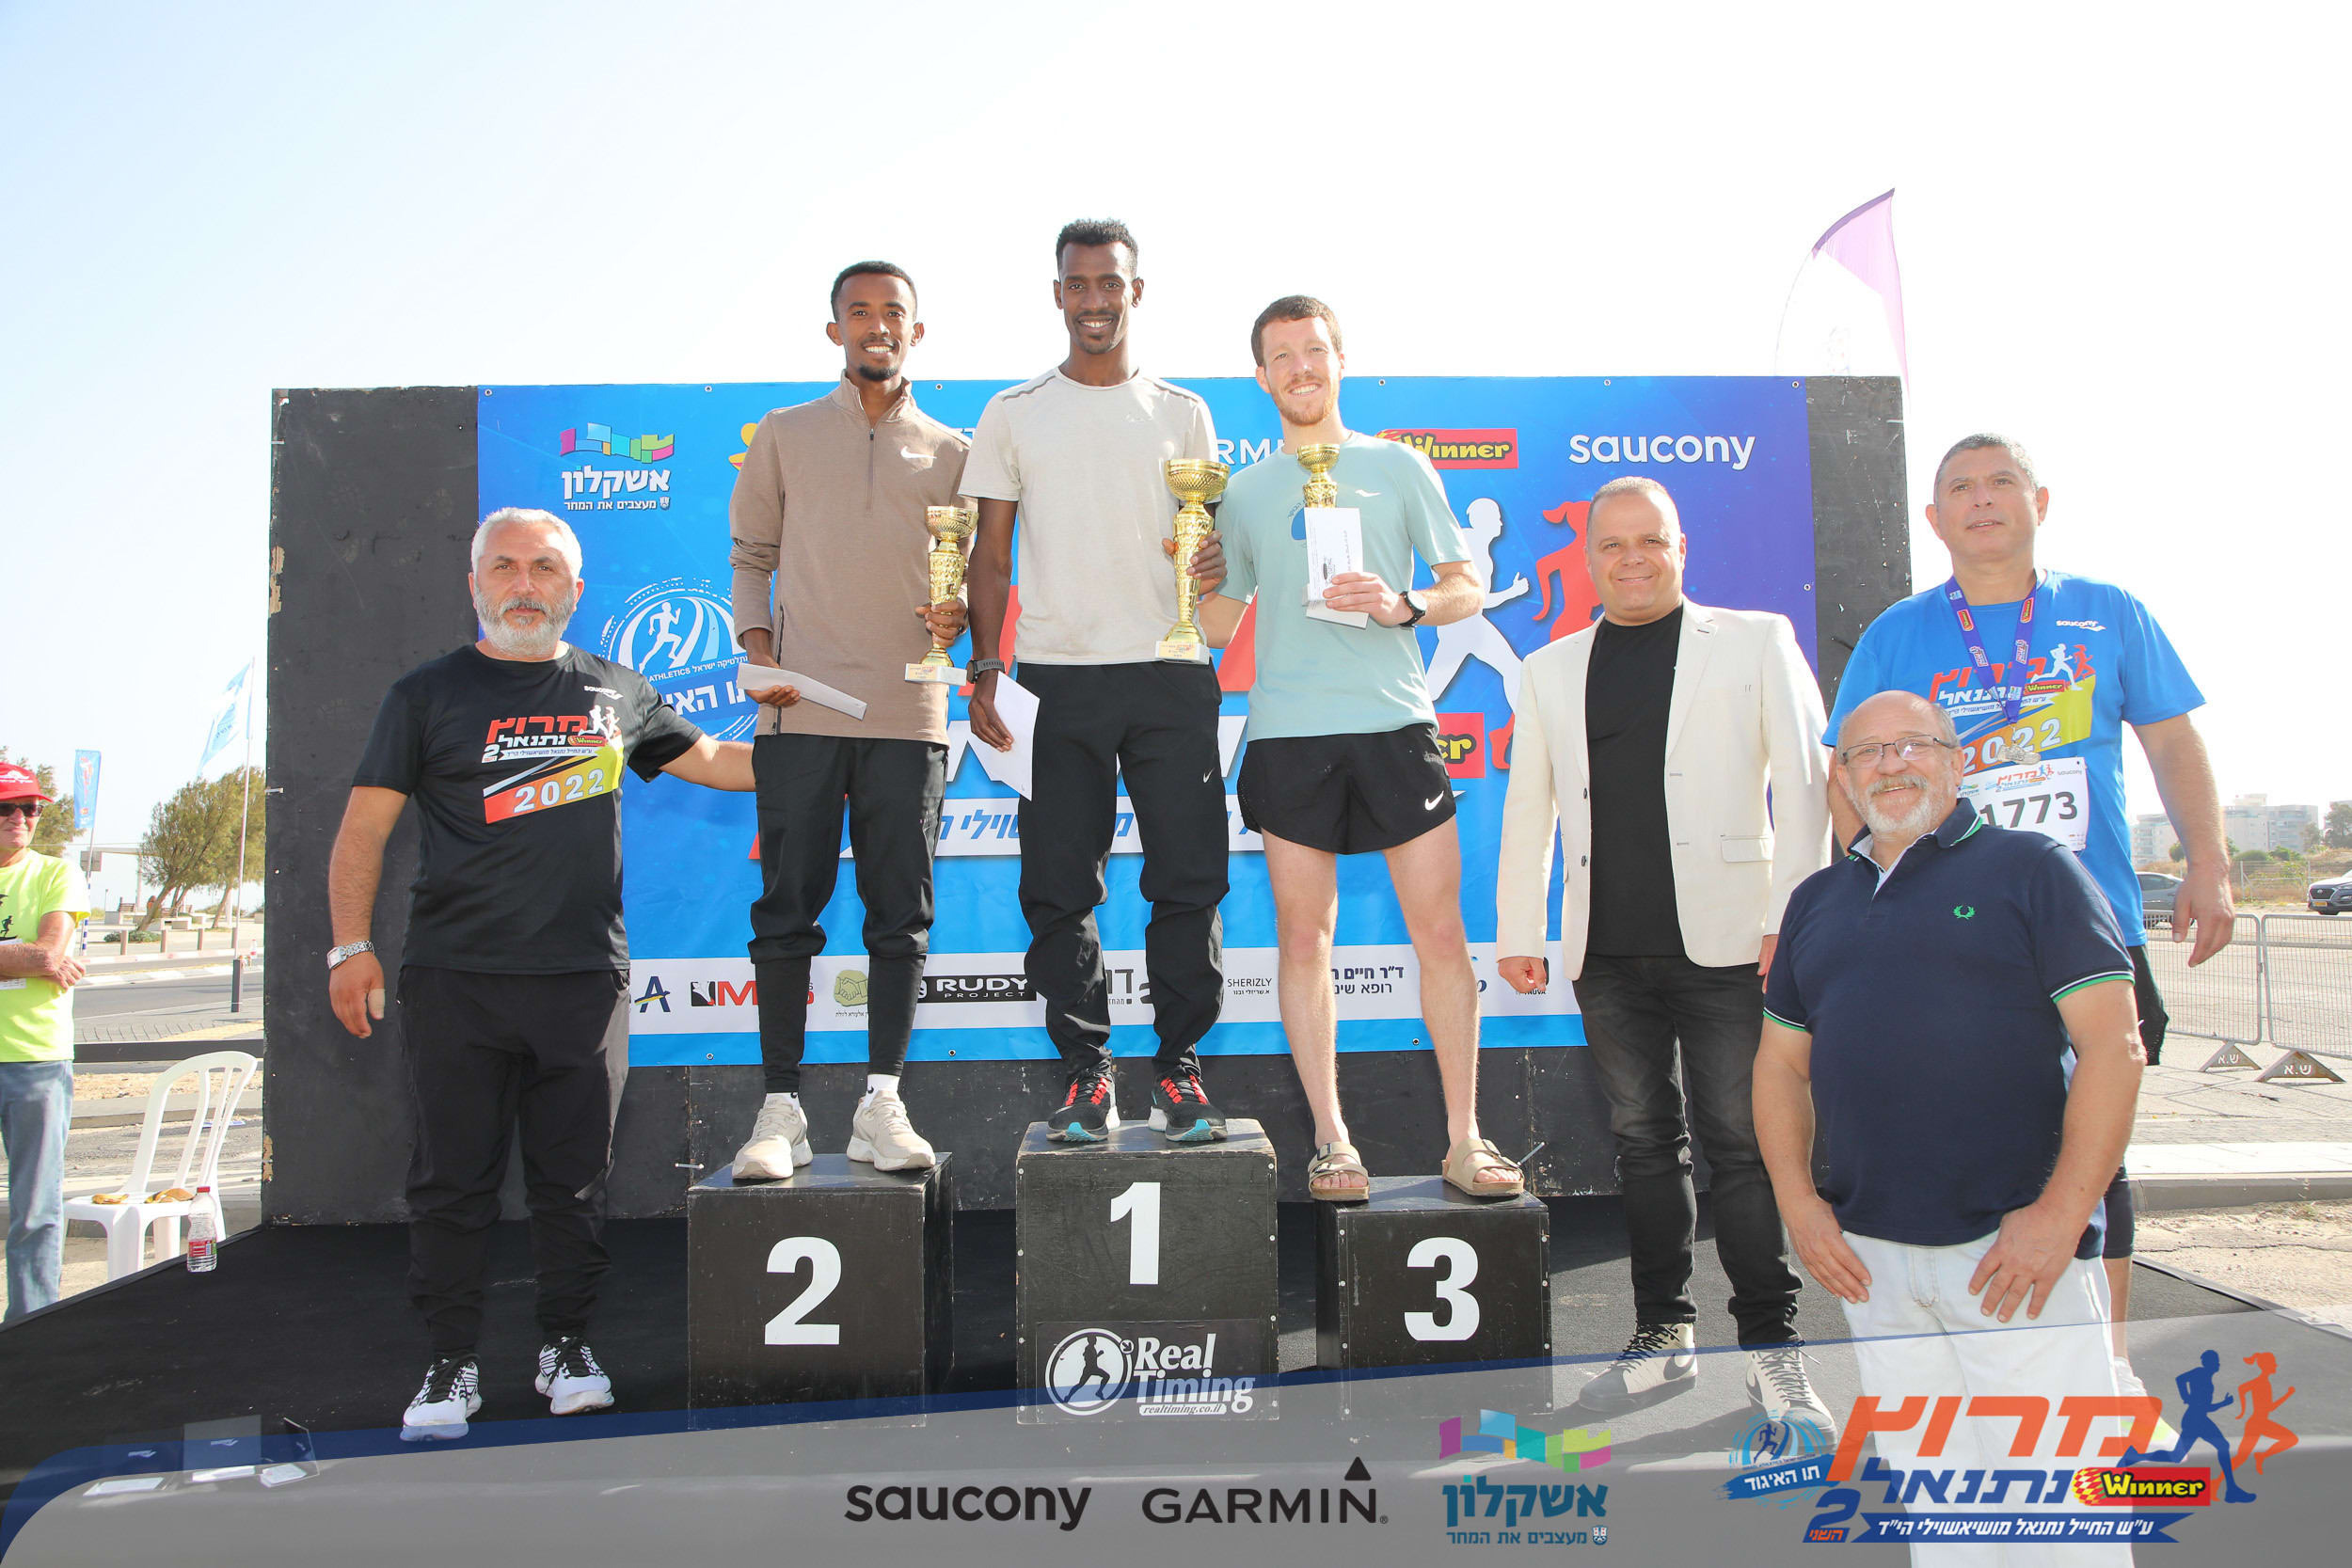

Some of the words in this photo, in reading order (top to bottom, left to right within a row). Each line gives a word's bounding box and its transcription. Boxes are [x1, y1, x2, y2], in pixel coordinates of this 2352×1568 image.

[1568, 434, 1755, 470] saucony
[562, 465, 671, 499] אשקלון
[564, 501, 594, 511] המחר
[597, 501, 613, 510] את
[616, 500, 657, 511] מעצבים
[648, 667, 691, 683] ATHLETICS
[2027, 683, 2063, 692] Winner
[486, 716, 588, 744] מרוץ
[498, 735, 566, 748] נתנאל
[514, 768, 604, 813] 2022
[1979, 791, 2077, 829] 1773
[1344, 968, 1375, 979] חיים
[1379, 966, 1405, 978] ד"ר
[936, 977, 1028, 991] RUDY
[1227, 977, 1272, 988] SHERIZLY
[1334, 984, 1356, 994] שינ
[1361, 983, 1392, 993] רופא
[1108, 1181, 1161, 1286] 1
[764, 1236, 842, 1346] 2
[1404, 1237, 1481, 1342] 3
[1134, 1333, 1216, 1370] Real
[1133, 1368, 1256, 1414] Timing
[1142, 1403, 1223, 1415] realtiming.co.il
